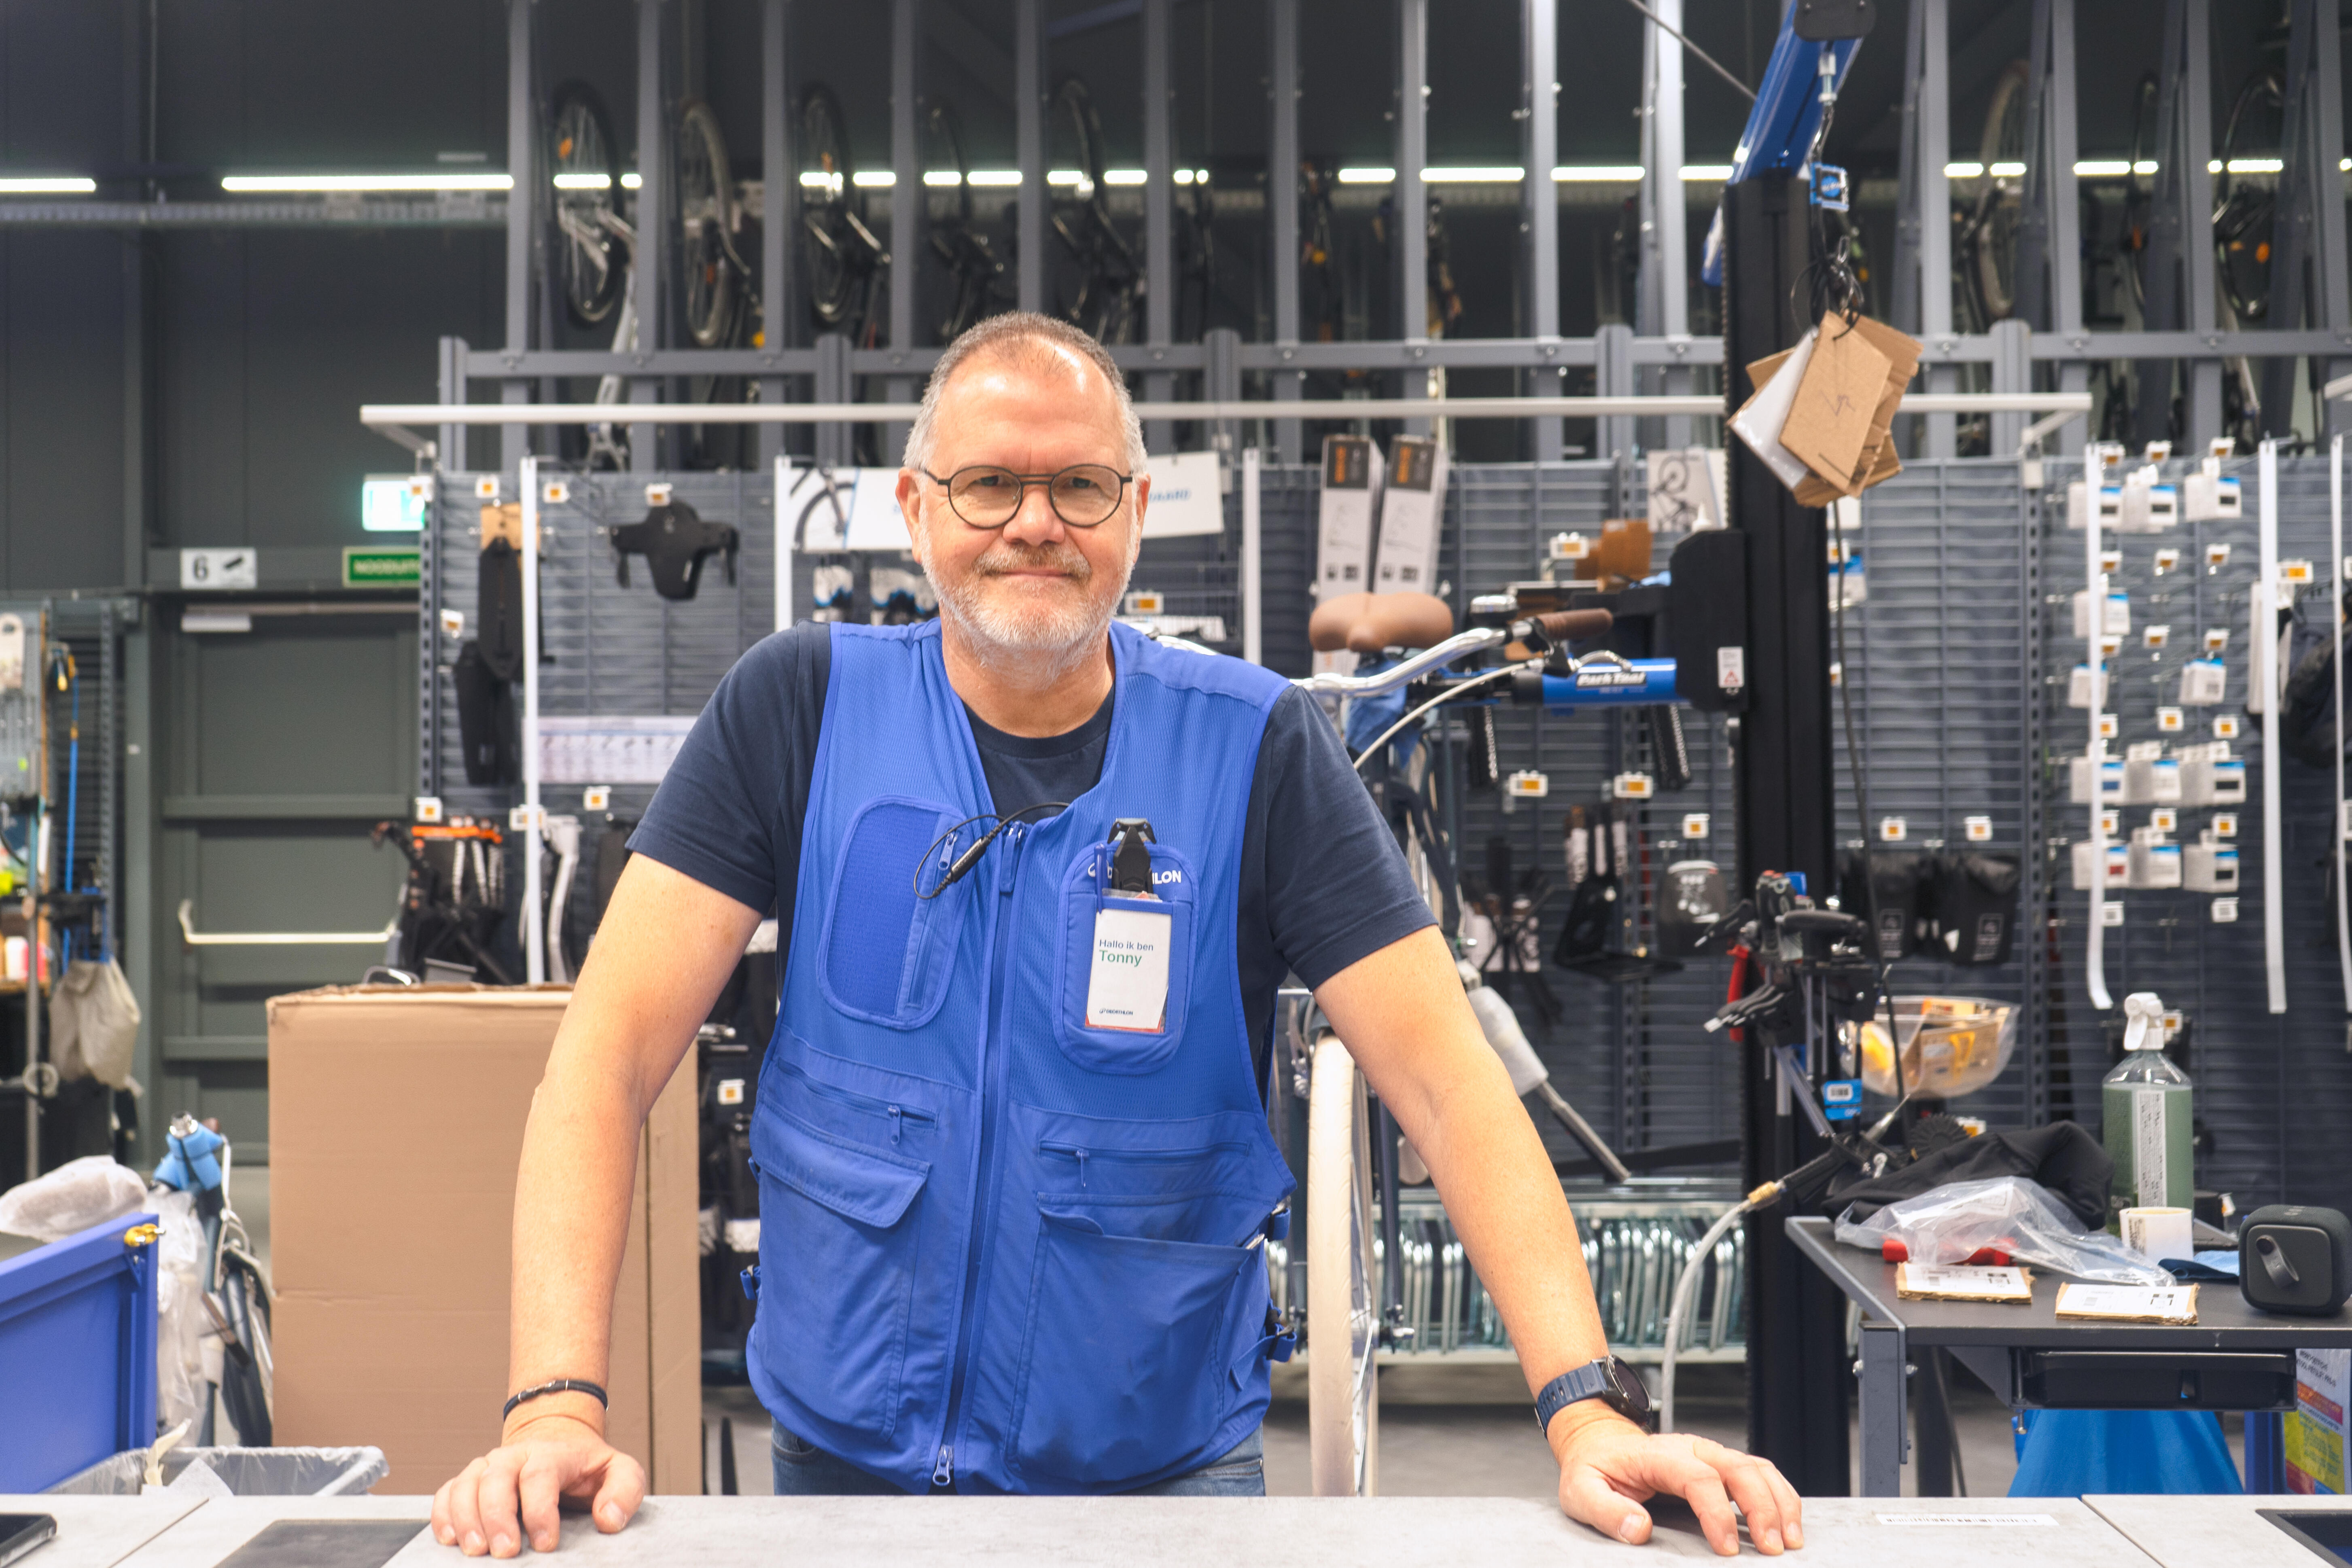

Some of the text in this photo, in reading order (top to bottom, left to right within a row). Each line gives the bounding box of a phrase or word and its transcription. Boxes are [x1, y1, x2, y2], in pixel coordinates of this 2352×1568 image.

[193, 555, 209, 582] 6
[1099, 939, 1124, 949] Hallo
[1137, 942, 1154, 951] ben
[1099, 949, 1142, 967] Tonny
